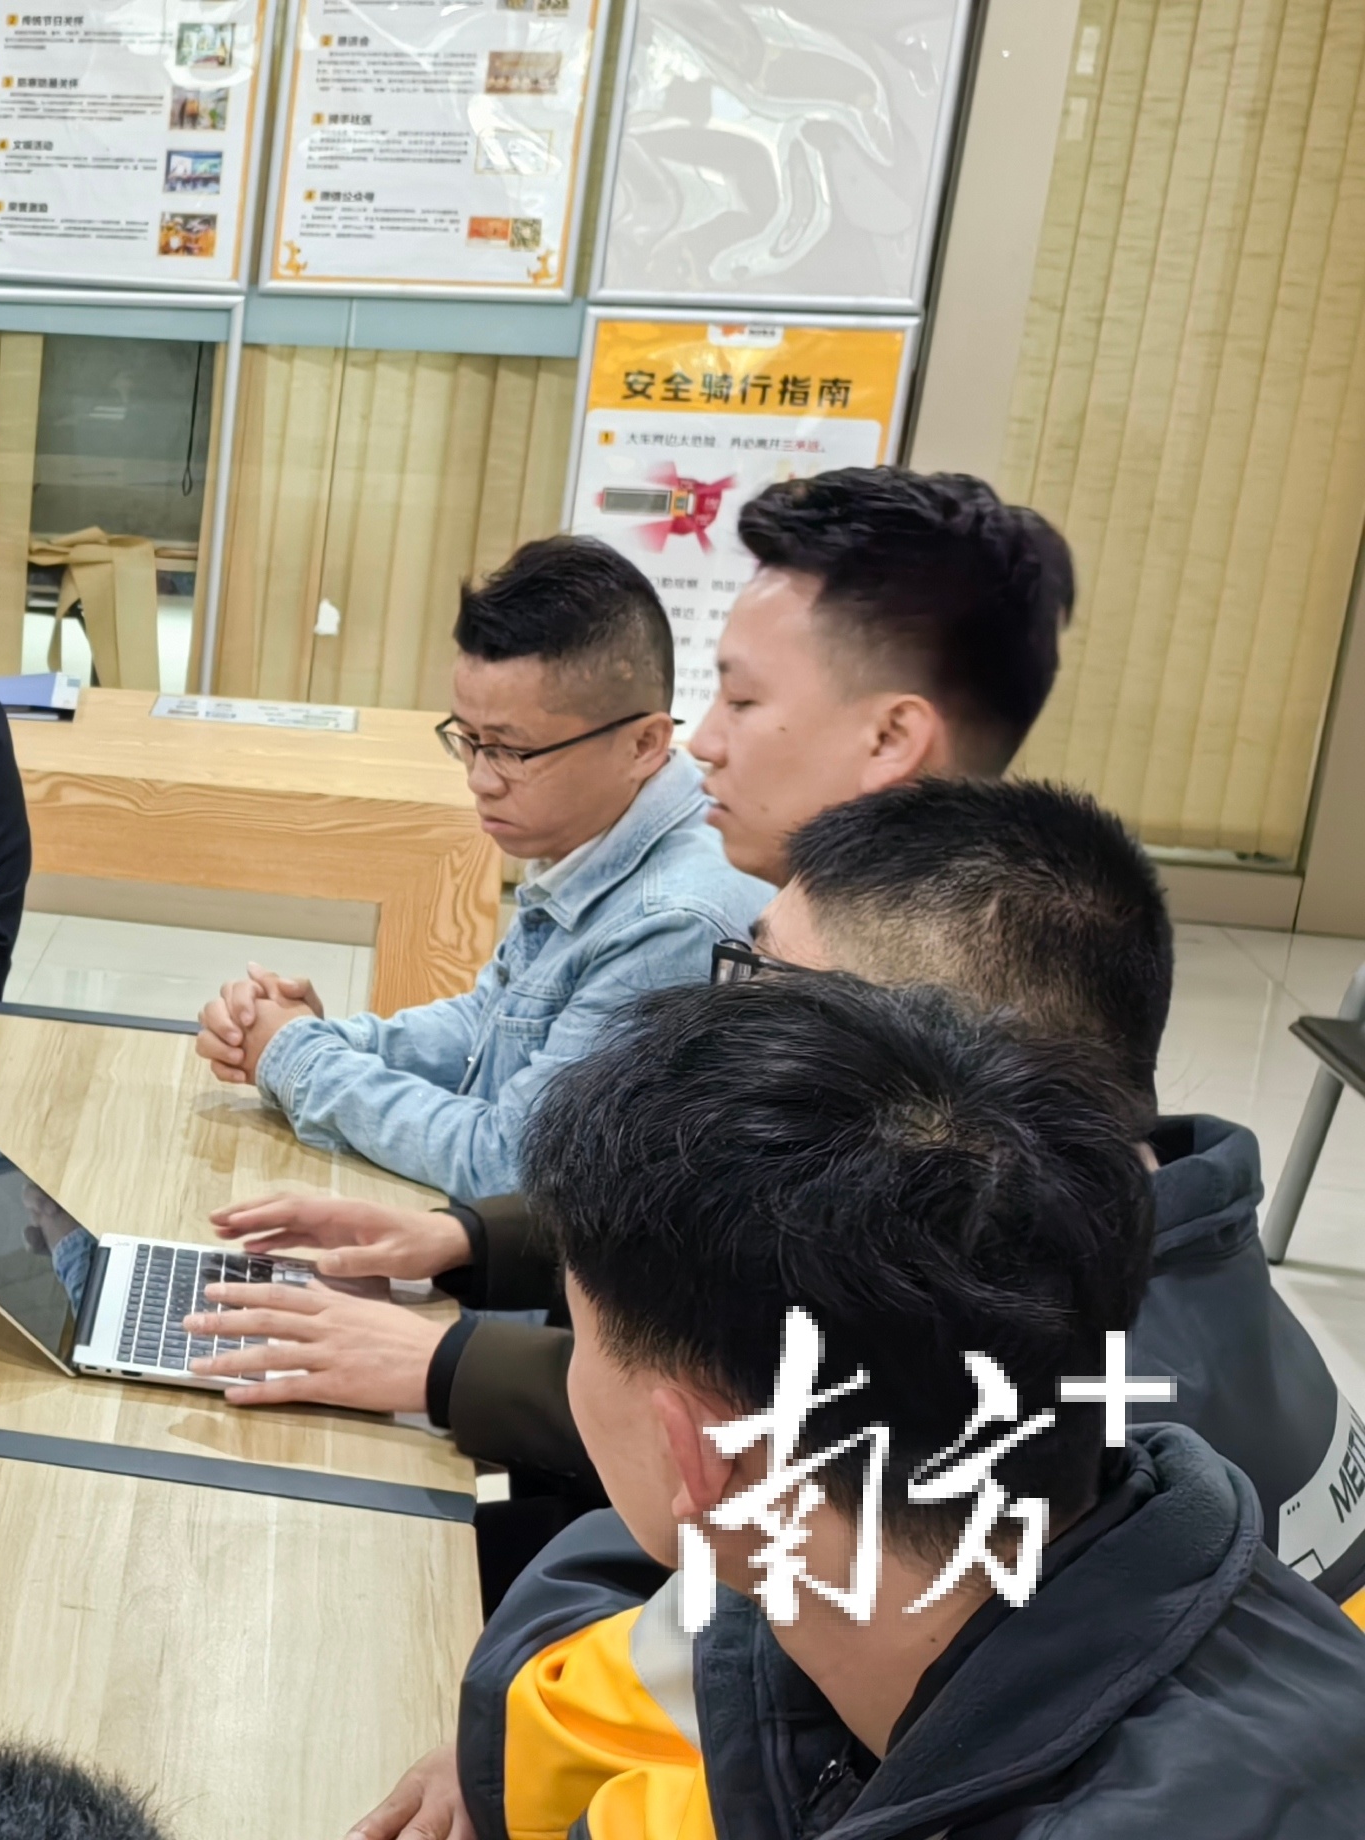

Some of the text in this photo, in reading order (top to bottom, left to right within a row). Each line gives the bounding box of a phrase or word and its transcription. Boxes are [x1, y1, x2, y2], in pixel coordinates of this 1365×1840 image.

[622, 370, 853, 410] 安全骑行指南
